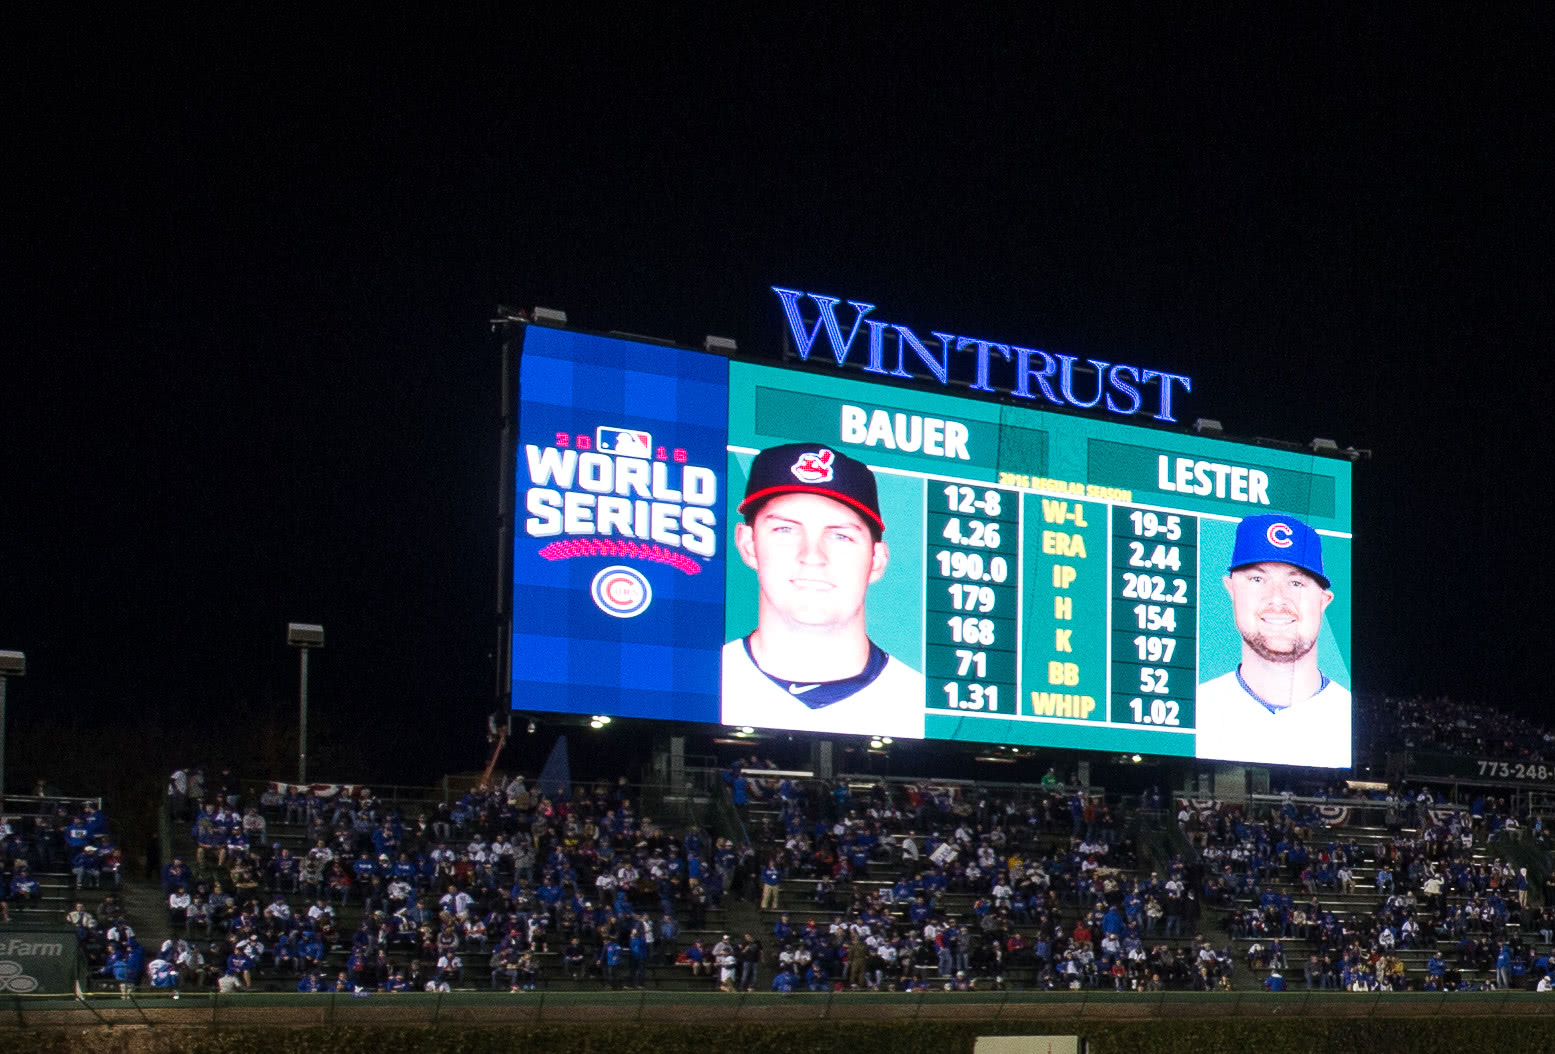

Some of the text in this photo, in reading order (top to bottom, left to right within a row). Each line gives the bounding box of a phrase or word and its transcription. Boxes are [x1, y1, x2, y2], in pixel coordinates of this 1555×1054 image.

[771, 286, 1191, 422] WINTRUST
[841, 405, 970, 461] BAUER
[525, 444, 717, 506] WORLD
[1031, 476, 1085, 496] REGULAR
[1086, 484, 1132, 503] SEASON
[1158, 455, 1270, 505] LESTER
[943, 484, 1002, 517] 12-8
[1042, 499, 1088, 527] W-L
[526, 487, 717, 557] SERIES
[943, 518, 1001, 549] 4.26
[1130, 511, 1182, 541] 19-5
[1042, 530, 1087, 559] ERA
[1129, 541, 1181, 571] 2.44
[936, 550, 1008, 582] 190.0
[1053, 564, 1077, 589] IP
[948, 583, 996, 613] 179
[1122, 573, 1188, 604] 202.2
[1054, 595, 1072, 621] H
[1133, 604, 1176, 632] 154
[948, 616, 995, 646] 168
[1055, 628, 1073, 653] K
[955, 649, 987, 678] 71
[1133, 635, 1176, 663] 197
[1048, 661, 1079, 686] BB
[1140, 667, 1169, 694] 52
[943, 681, 998, 711] 1.31
[1031, 691, 1096, 719] WHIP
[1129, 698, 1180, 726] 1.02
